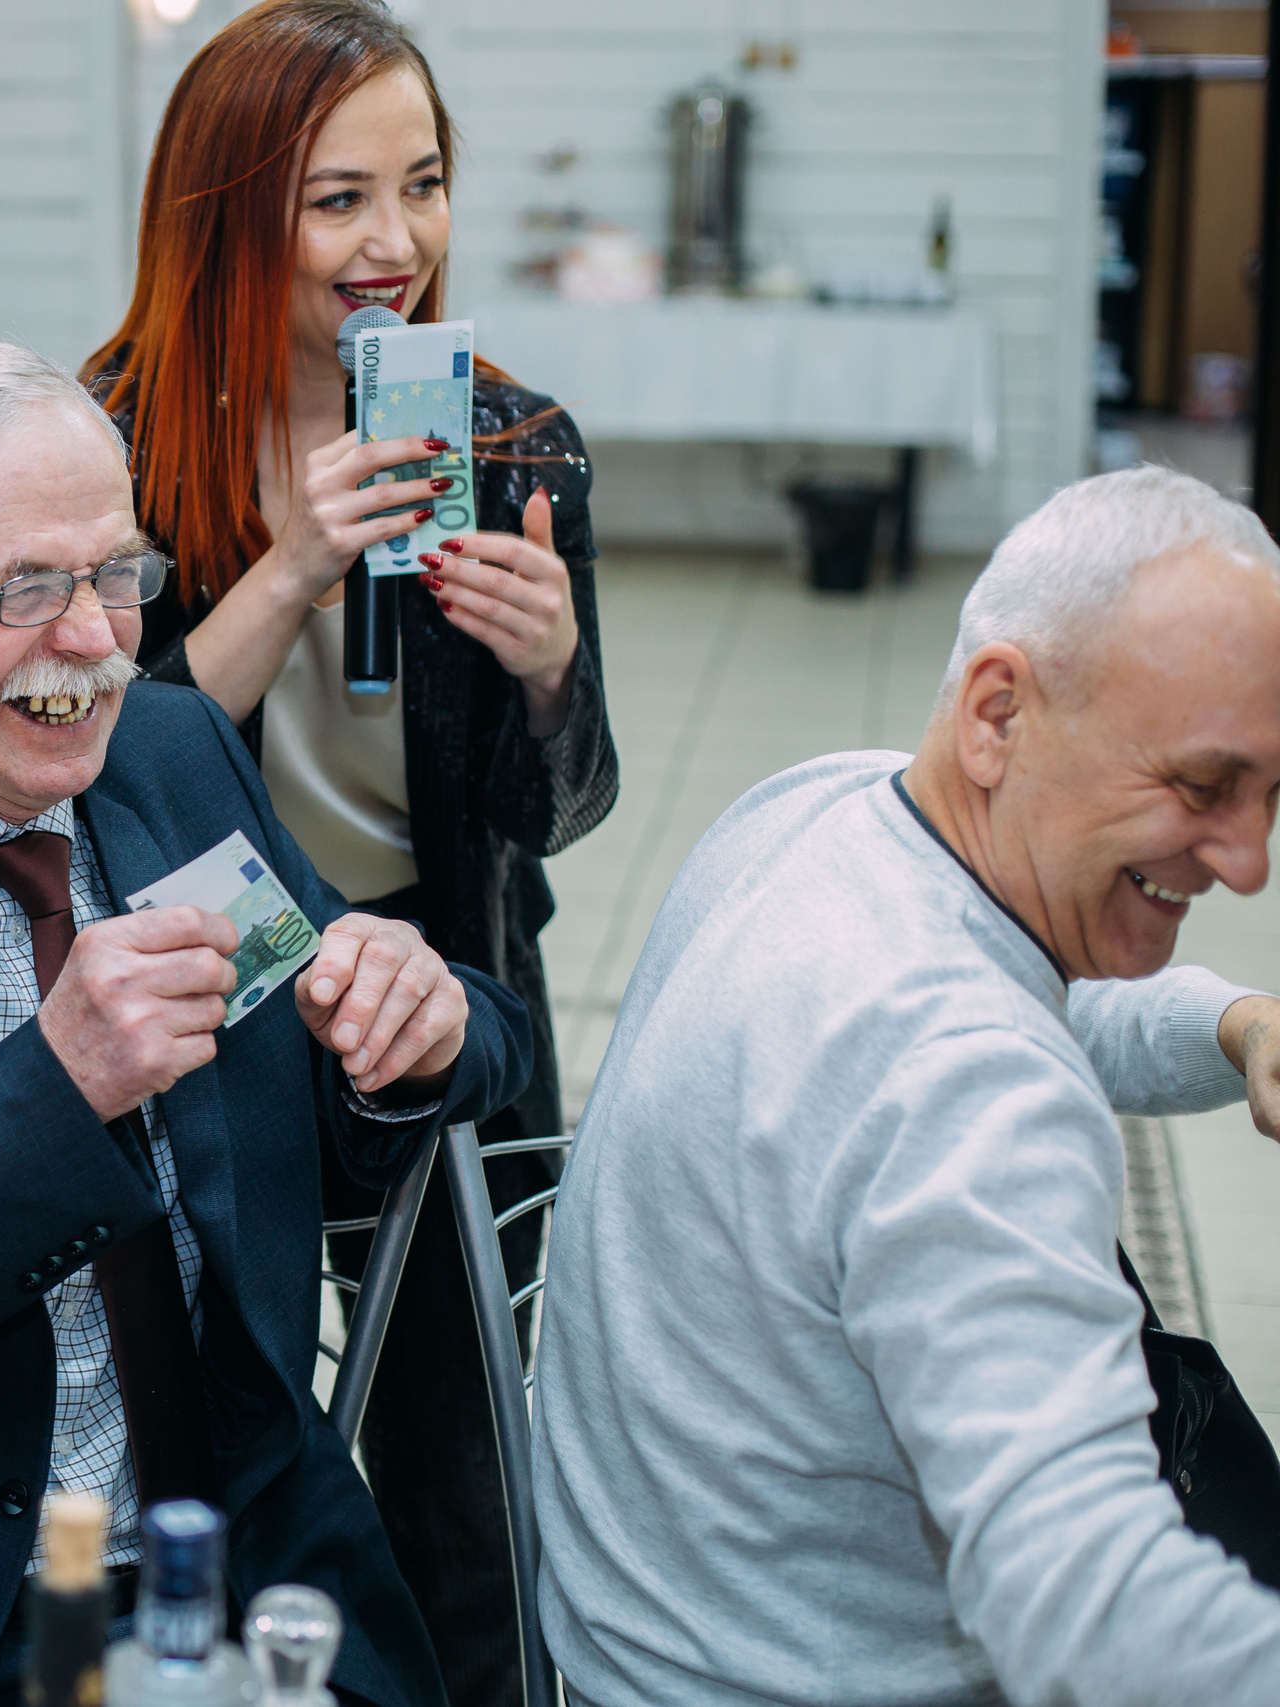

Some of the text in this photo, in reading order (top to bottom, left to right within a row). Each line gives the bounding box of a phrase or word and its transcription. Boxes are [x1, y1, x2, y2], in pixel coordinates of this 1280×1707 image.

[363, 336, 380, 400] 100 EURO
[433, 457, 470, 531] 100
[267, 910, 314, 961] 100
